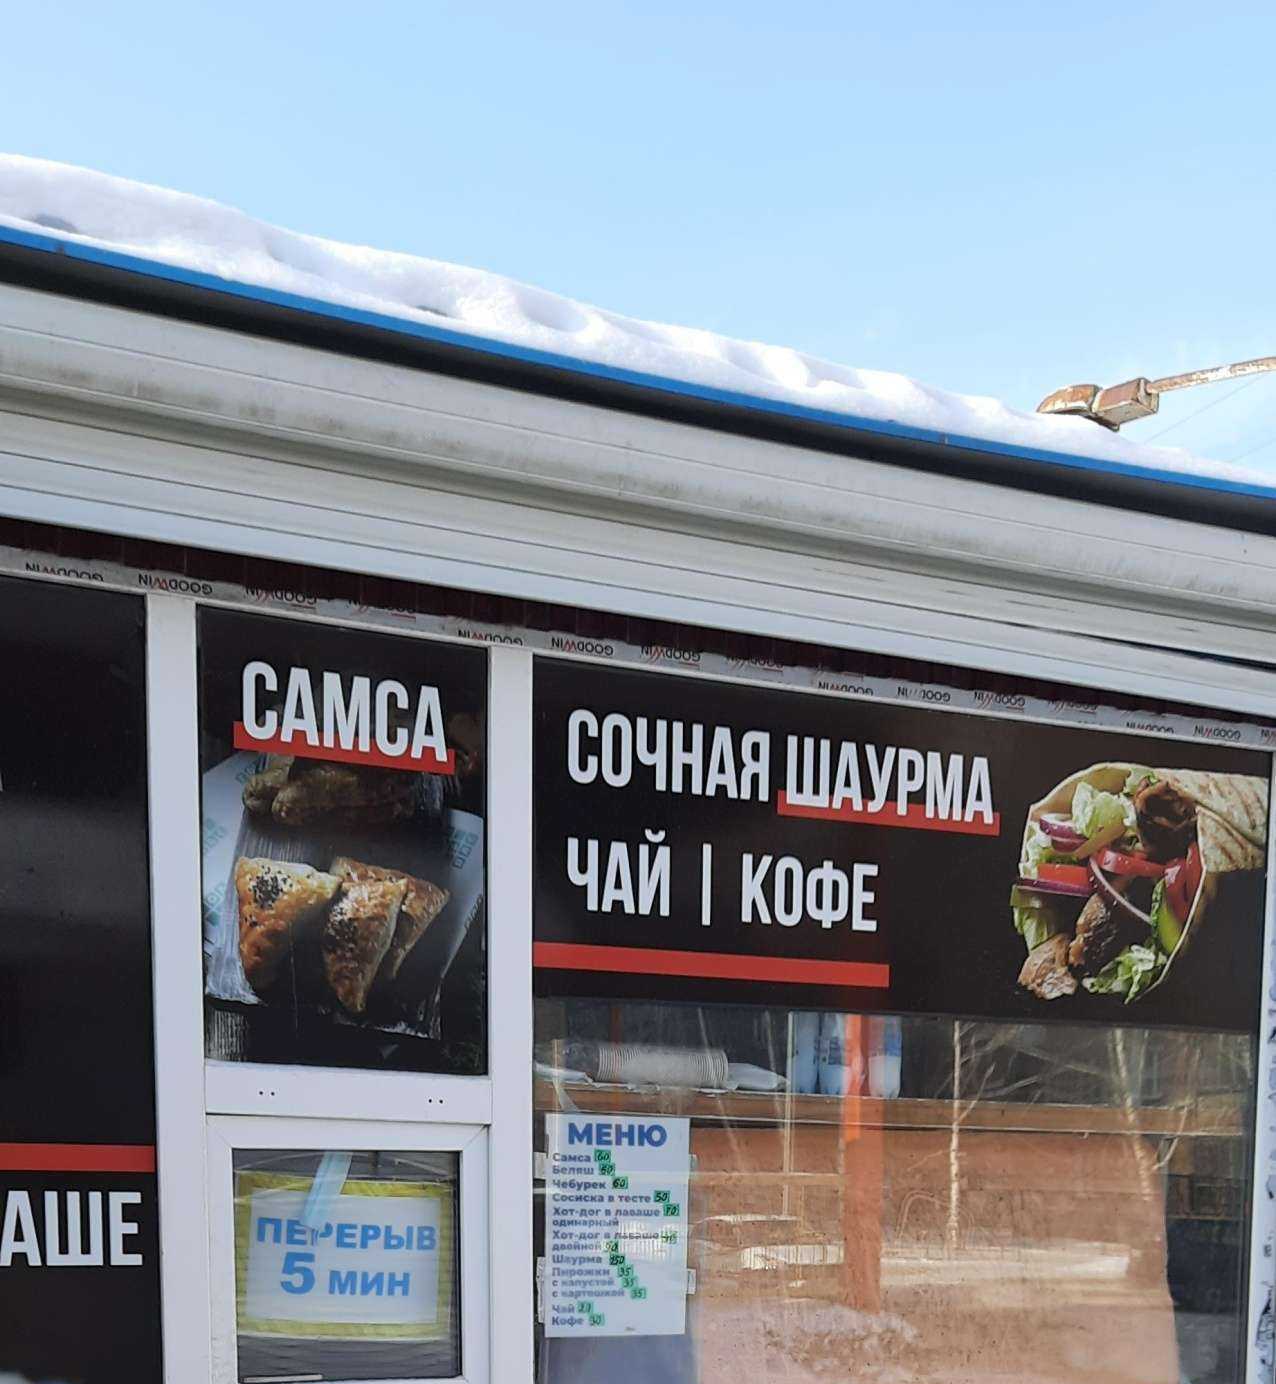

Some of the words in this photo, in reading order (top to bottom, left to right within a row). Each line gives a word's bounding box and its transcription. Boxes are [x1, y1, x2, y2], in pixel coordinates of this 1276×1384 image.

[138, 573, 213, 595] GOODWIN
[551, 637, 614, 656] GOODWIN
[640, 645, 700, 663] GOODWIN
[241, 660, 450, 763] САМСА
[567, 708, 771, 803] СОЧНАЯ
[785, 734, 995, 825] ШАУРМА
[566, 828, 671, 917] ЧАЙ
[741, 852, 879, 933] КОФЕ
[568, 1122, 668, 1148] МЕНЮ
[552, 1153, 592, 1163] Самса
[552, 1164, 595, 1176] Беляш
[552, 1179, 607, 1192] Чебурек
[552, 1192, 605, 1203] Сосиска
[607, 1194, 615, 1203] в
[617, 1194, 652, 1204] тесте
[553, 1206, 601, 1217] Хот-дог
[604, 1209, 612, 1217] в
[615, 1209, 661, 1218] лаваше
[0, 1189, 143, 1267] АШЕ
[552, 1217, 620, 1229] одинарный
[552, 1230, 601, 1241] Хот-дог
[603, 1232, 611, 1240] в
[552, 1254, 603, 1266] Шаурма
[279, 1251, 316, 1295] 5
[328, 1270, 411, 1297] МИН
[552, 1303, 575, 1314] Чай
[552, 1315, 585, 1327] Кофе
